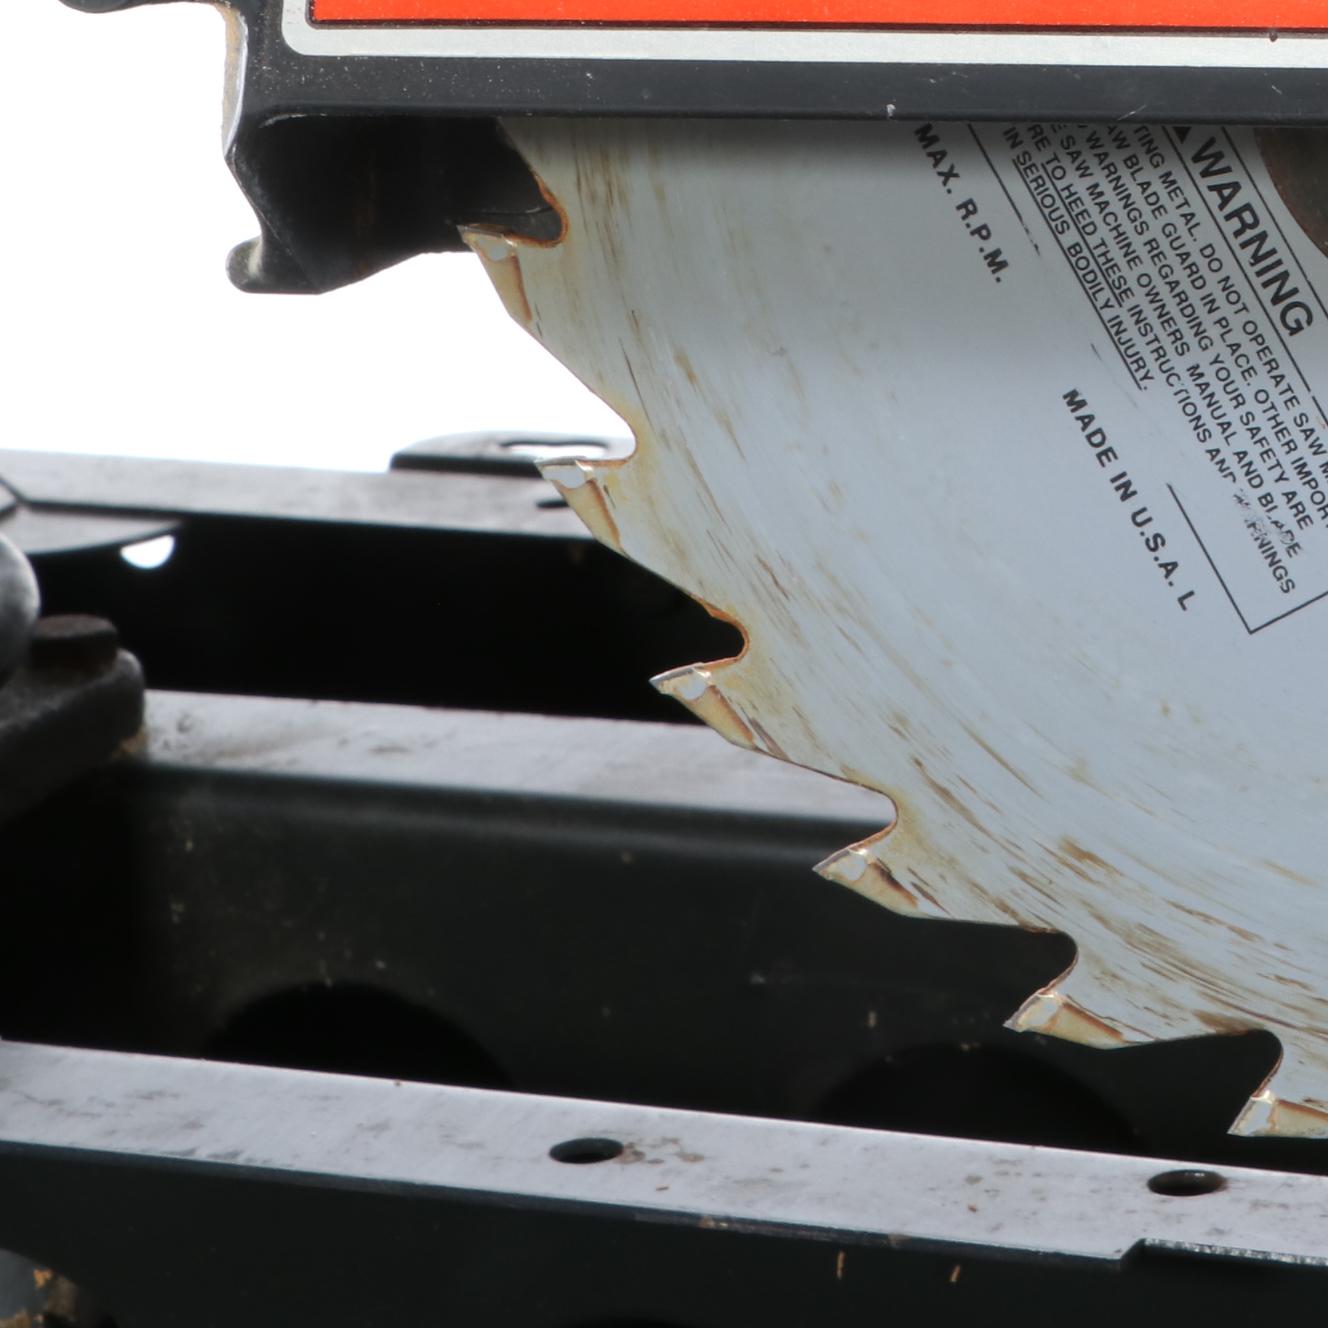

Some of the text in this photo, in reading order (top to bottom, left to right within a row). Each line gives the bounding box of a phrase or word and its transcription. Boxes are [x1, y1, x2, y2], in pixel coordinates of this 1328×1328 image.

[915, 123, 1009, 283] MAX. R.P.M.
[1003, 127, 1155, 390] IN SERIOUS BODILY INJURY.
[1045, 152, 1066, 180] TO
[1059, 183, 1098, 236] HEED
[1091, 236, 1135, 303] THESE
[1060, 135, 1094, 178] SAW
[1085, 181, 1143, 271] MACHINE
[1136, 272, 1190, 357] OWNERS
[1185, 362, 1237, 446] MANUAL
[1231, 449, 1264, 489] AND
[1086, 131, 1314, 530] WARNINGS REGARDING YOUR SAFETY ARE
[1122, 153, 1168, 220] BLADE
[1160, 222, 1206, 290] GUARD
[1199, 291, 1221, 315] IN
[1212, 315, 1258, 386] PLACE.
[1253, 388, 1298, 455] OTHER
[1158, 170, 1200, 242] METAL.
[1198, 242, 1223, 273] DO
[1216, 274, 1250, 315] NOT
[1241, 319, 1300, 411] OPERATE
[1292, 411, 1327, 456] SAW
[1191, 137, 1313, 337] WARNING
[1061, 388, 1118, 468] MADE
[1109, 470, 1138, 502] IN
[1130, 506, 1179, 587] U.S.A.
